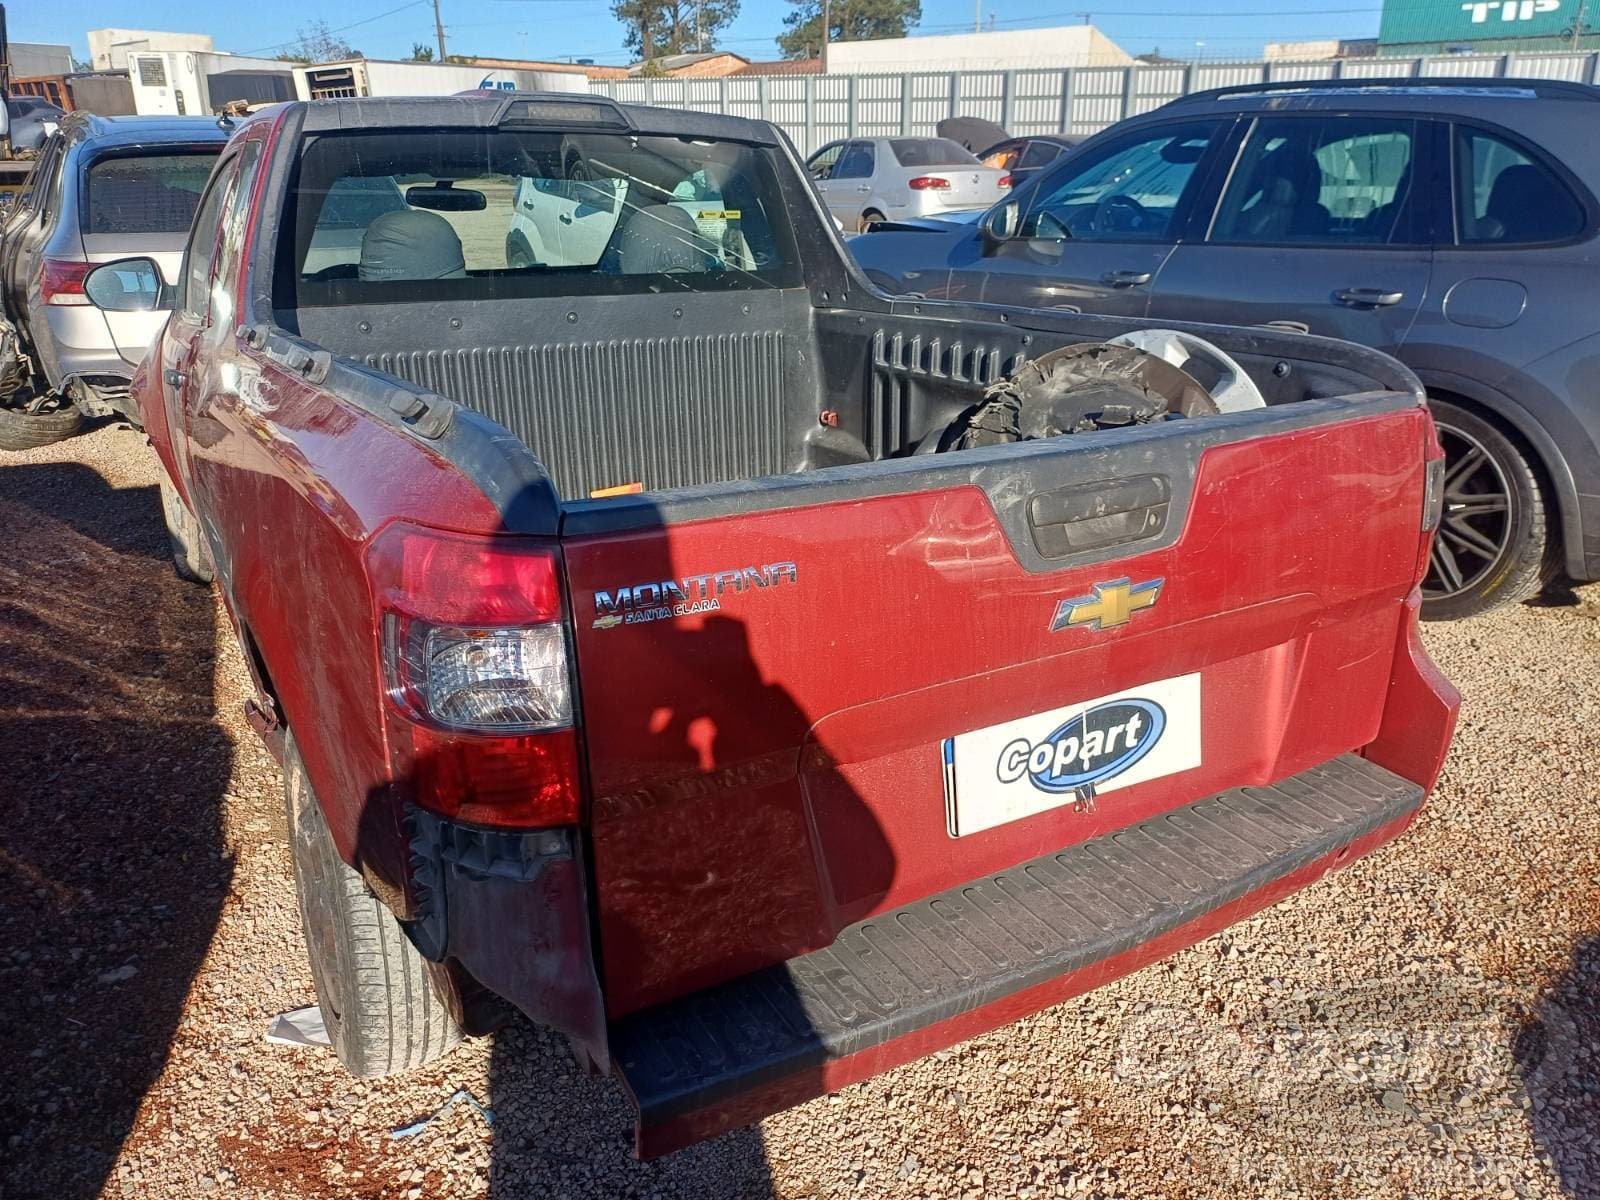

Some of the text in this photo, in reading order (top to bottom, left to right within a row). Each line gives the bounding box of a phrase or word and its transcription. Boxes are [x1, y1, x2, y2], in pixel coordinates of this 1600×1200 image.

[1461, 0, 1560, 23] TIP
[594, 561, 797, 614] MONTANA
[625, 598, 720, 625] SANTA CLARA
[997, 712, 1142, 783] Copart
